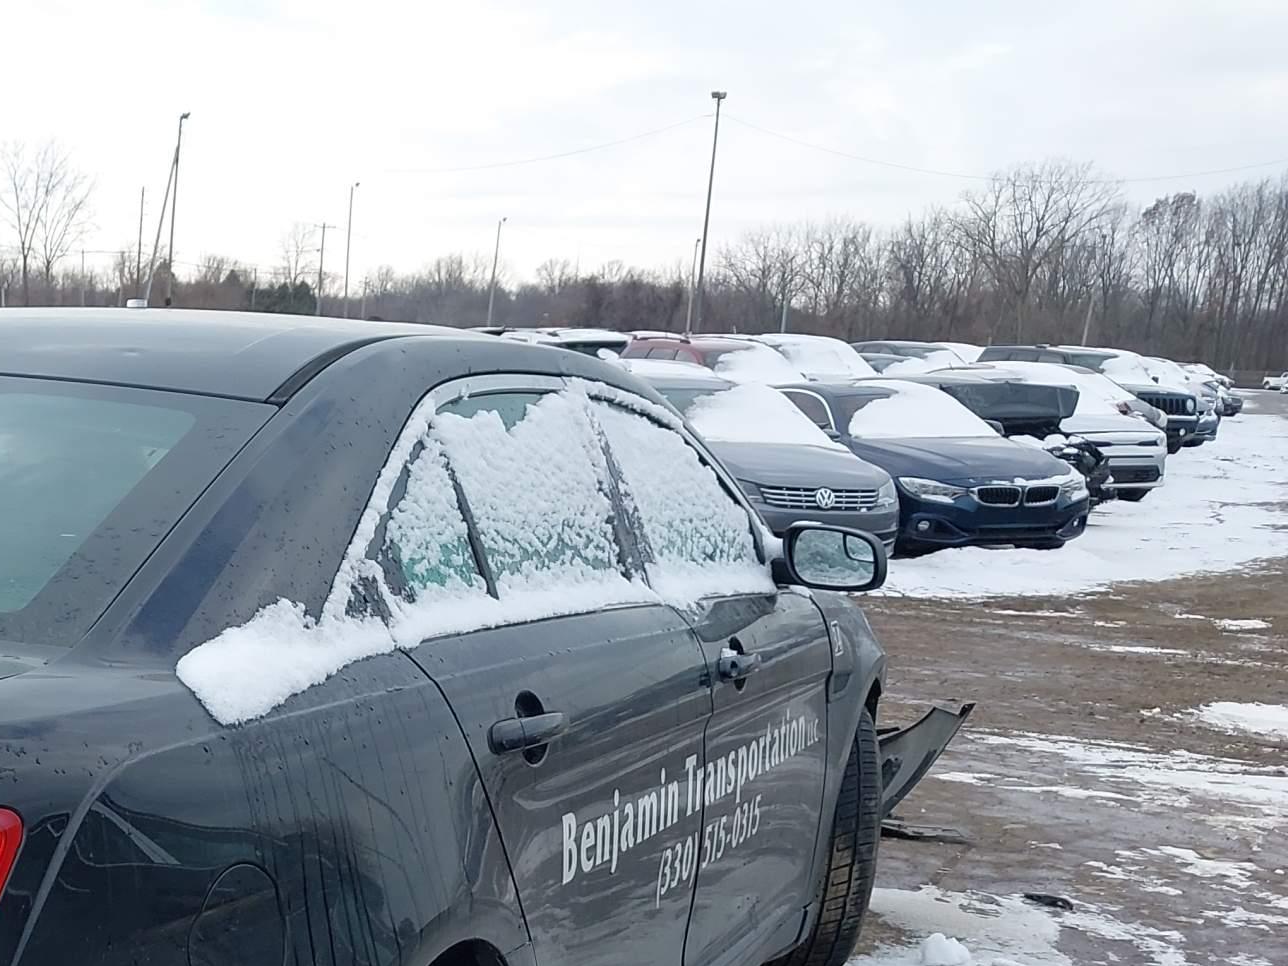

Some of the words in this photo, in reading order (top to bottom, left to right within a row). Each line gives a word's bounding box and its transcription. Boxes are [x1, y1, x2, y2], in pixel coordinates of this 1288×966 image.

[562, 767, 680, 886] Benjamin
[685, 709, 806, 817] Transportation
[655, 830, 699, 909] (330)
[701, 794, 763, 869] 515-0315
